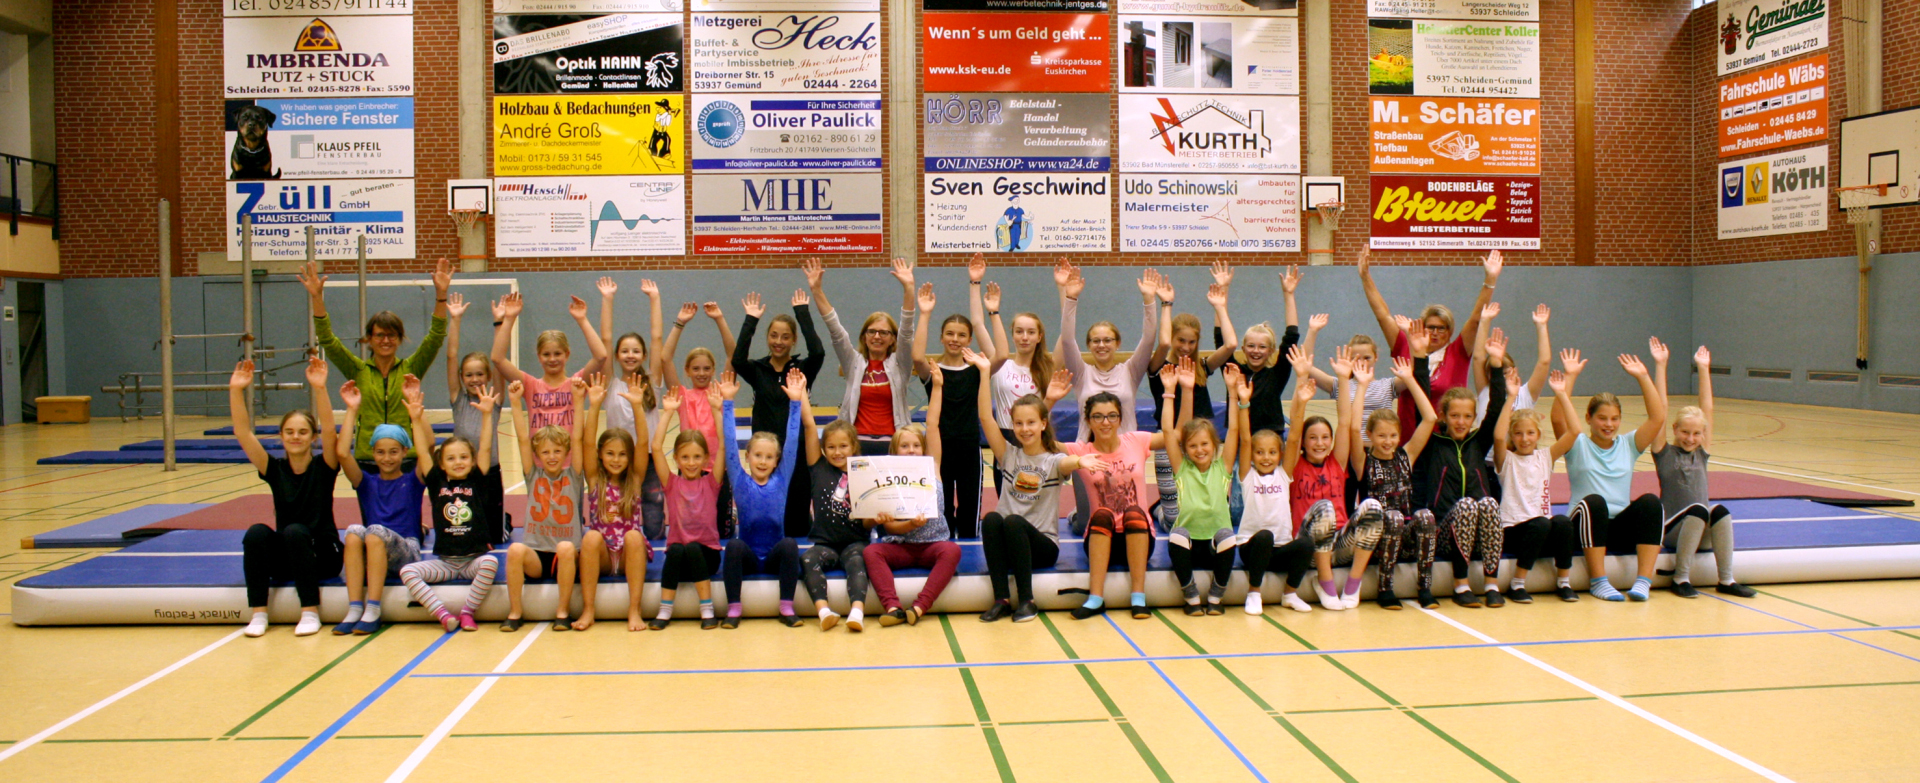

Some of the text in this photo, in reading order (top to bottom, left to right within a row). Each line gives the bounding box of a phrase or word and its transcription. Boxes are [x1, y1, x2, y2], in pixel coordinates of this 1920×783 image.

[1470, 8, 1491, 16] 53937
[1494, 9, 1529, 17] Schleiden
[586, 15, 628, 30] easySHOP
[694, 16, 762, 30] Metzgerei
[526, 28, 570, 44] BRILLENABO
[752, 15, 877, 50] Heck
[989, 29, 1011, 40] um
[1016, 27, 1048, 40] Geld
[1052, 28, 1085, 43] geht
[1505, 26, 1538, 37] Koller
[695, 39, 728, 47] Buffet-
[694, 49, 759, 58] Partyservice
[1743, 38, 1818, 67] Gemünd 02444-2723
[247, 53, 389, 68] IMBRENDA
[601, 56, 641, 69] HAHN
[727, 59, 795, 67] Imbissbetrieb
[695, 71, 742, 79] Dreiborner
[745, 71, 760, 79] Str.
[929, 65, 1011, 75] www.ksk-eu.de
[261, 71, 375, 82] PUTZ + STUCK
[1454, 76, 1532, 85] Schleiden-Gemünd
[725, 81, 762, 89] Gemünd
[803, 80, 877, 89] 02444 2264
[1720, 72, 1785, 102] Fahrschule
[1789, 63, 1824, 86] Wäbs
[227, 86, 279, 94] Schleiden
[1442, 86, 1485, 94] Tel. 02444
[334, 104, 356, 112] gegen
[1010, 100, 1056, 108] Edelstahl
[499, 102, 651, 117] Holzbau & Bedachungen
[927, 94, 1003, 125] HÖRR
[1210, 99, 1247, 124] TECHNIK
[1373, 101, 1536, 125] M. Schäfer
[281, 112, 399, 125] Sichere Fenster
[753, 112, 875, 128] Oliver Paulick
[1023, 113, 1059, 122] Handel
[500, 122, 602, 139] André Groß
[1024, 126, 1087, 135] Verarbeitung
[1727, 123, 1759, 136] Schleiden
[794, 134, 876, 143] 02162 890 61 29
[1374, 131, 1424, 140] Straßenbau
[1721, 126, 1824, 153] www.Fahrschule-Waebs.de
[1024, 138, 1108, 147] Geländerzubehör
[1179, 132, 1257, 150] KURTH
[317, 142, 381, 151] KLAUS PFEIL
[1374, 143, 1408, 152] Tiefbau
[500, 154, 525, 162] Mobil:
[528, 154, 550, 162] 0173
[558, 154, 569, 162] 59
[572, 154, 582, 162] 31
[1374, 155, 1434, 166] Außenanlagen
[1772, 155, 1806, 167] AUTOHAUS
[500, 163, 602, 172] www.gross-bedachung.de
[725, 160, 798, 168] info@oliver-paulick.de
[936, 158, 1099, 169] ONLINESHOP: www.va24.de
[1772, 166, 1825, 194] KÖTH
[350, 182, 394, 196] gut beraten
[930, 176, 1106, 196] Sven Geschwind
[1125, 179, 1238, 196] Udo Schinowski
[1428, 180, 1494, 192] BODENBELÄGE
[741, 178, 833, 211] MHE
[1510, 189, 1528, 197] Belag
[1747, 195, 1767, 203] RENAULT
[339, 201, 370, 209] GmbH
[937, 203, 967, 211] Heizung
[1125, 202, 1209, 212] Malermeister
[1373, 186, 1497, 223] Breuer
[258, 214, 332, 223] HAUSTECHNIK
[366, 225, 404, 234] Klima
[1410, 225, 1491, 233] MEISTERBETRIEB
[931, 241, 991, 249] Meisterbetrieb
[1126, 239, 1296, 248] Tel. Mobil 0170 3156783
[919, 477, 927, 487] €
[1253, 485, 1282, 494] adidas
[154, 608, 242, 620] AirTrack Factory
